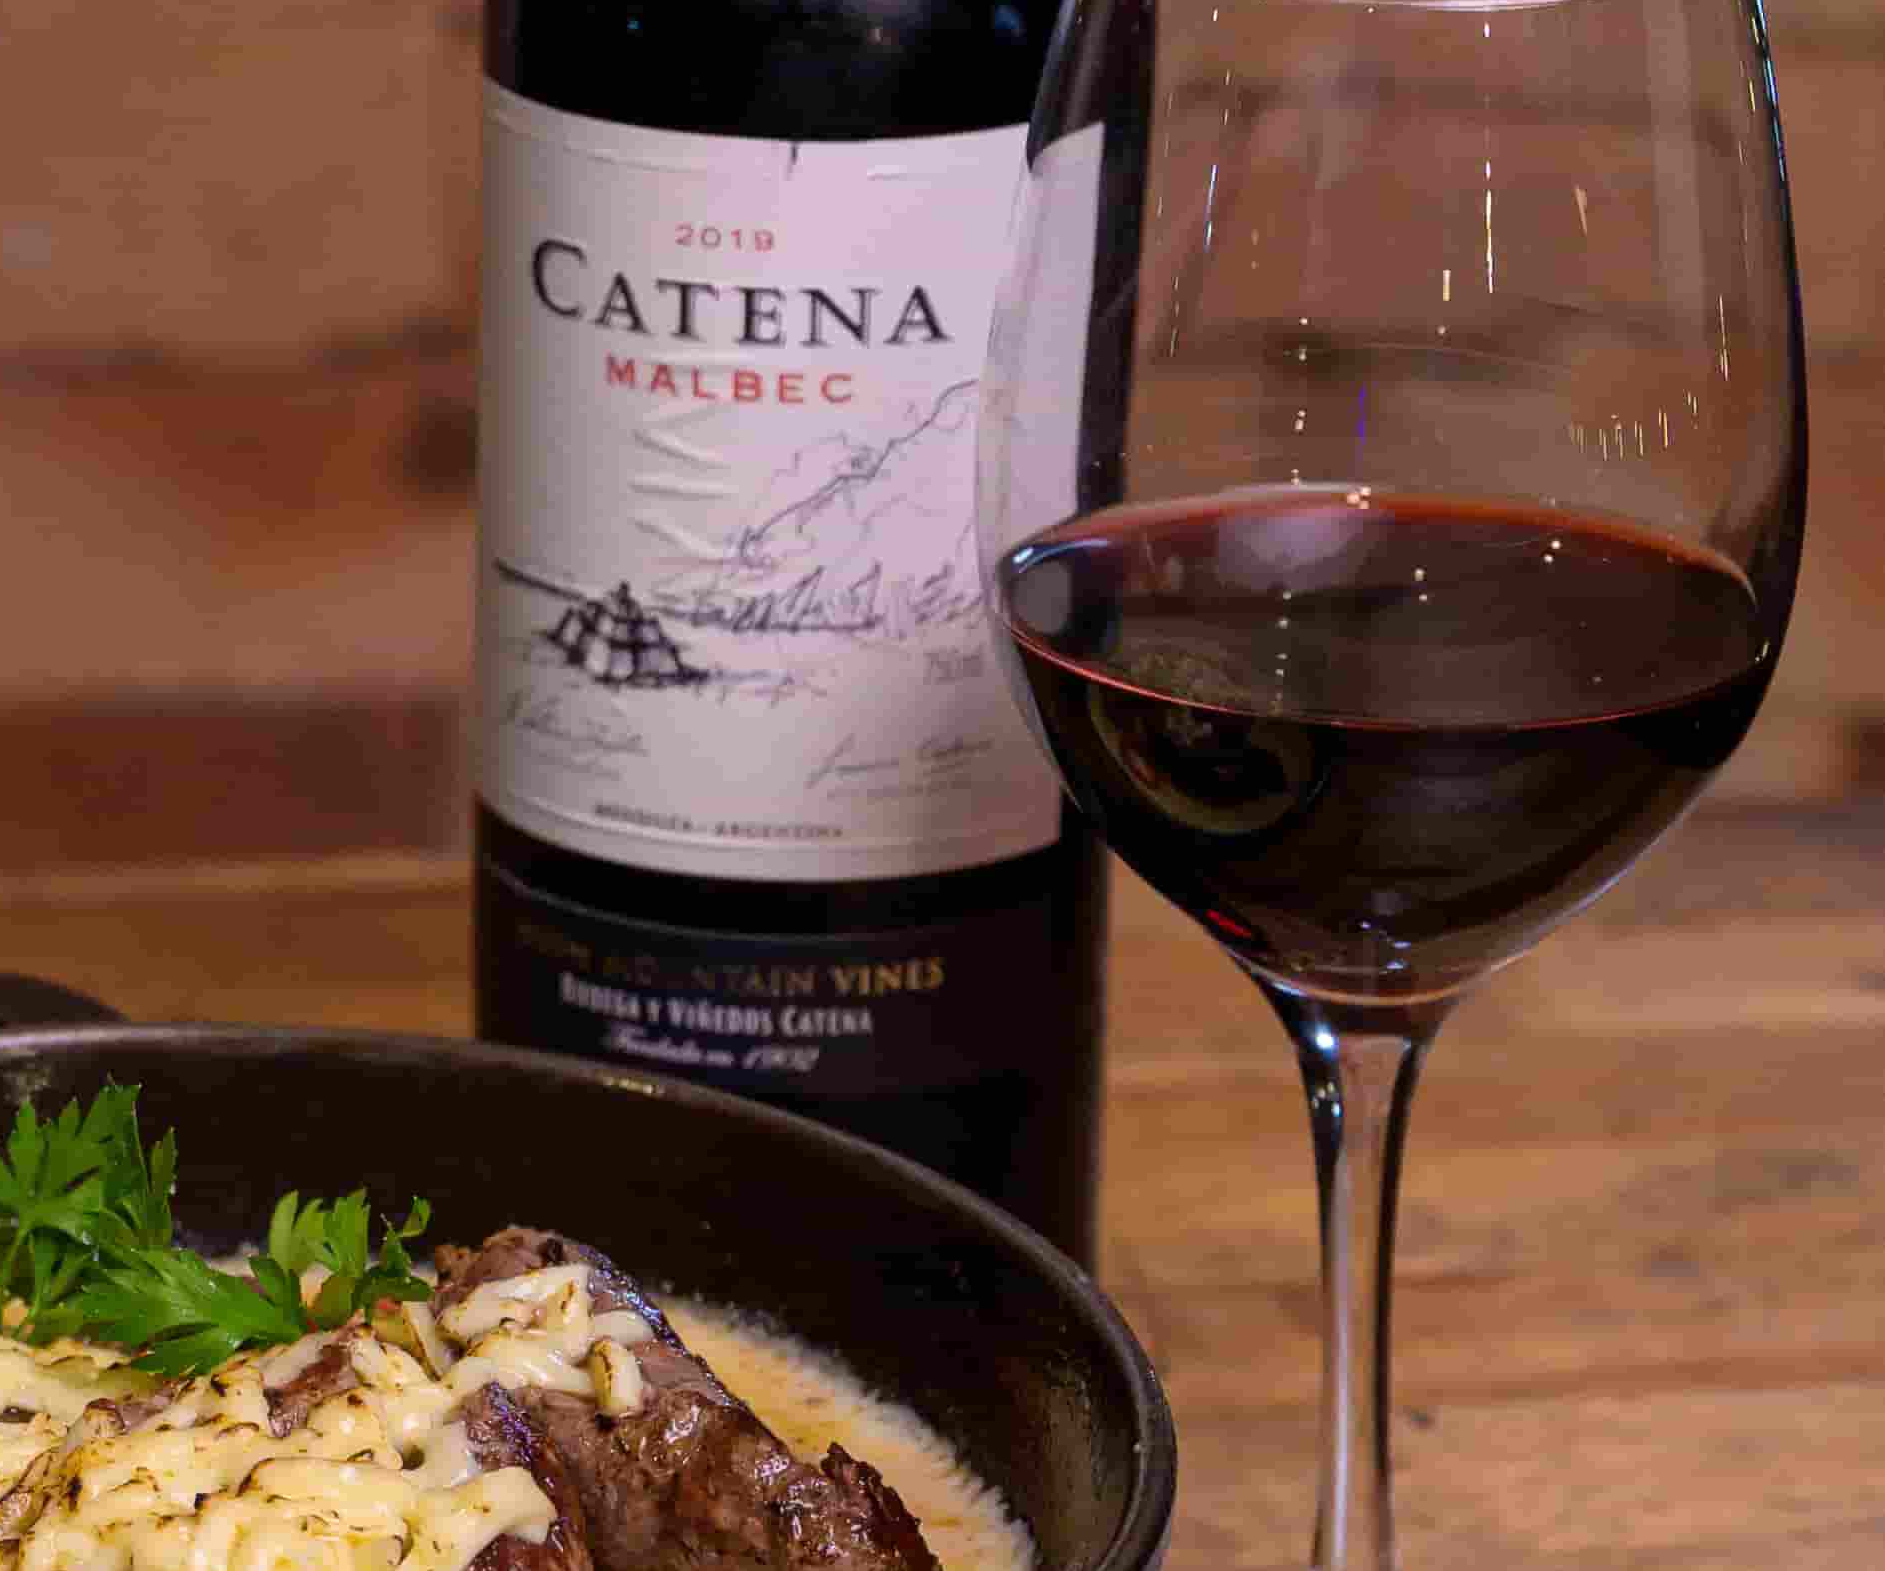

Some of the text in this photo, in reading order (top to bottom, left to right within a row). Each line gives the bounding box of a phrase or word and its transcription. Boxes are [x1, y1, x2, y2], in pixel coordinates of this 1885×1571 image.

[675, 225, 775, 251] 2019
[532, 238, 953, 347] CATENA
[604, 353, 857, 405] MALBEC
[829, 956, 946, 998] VINES
